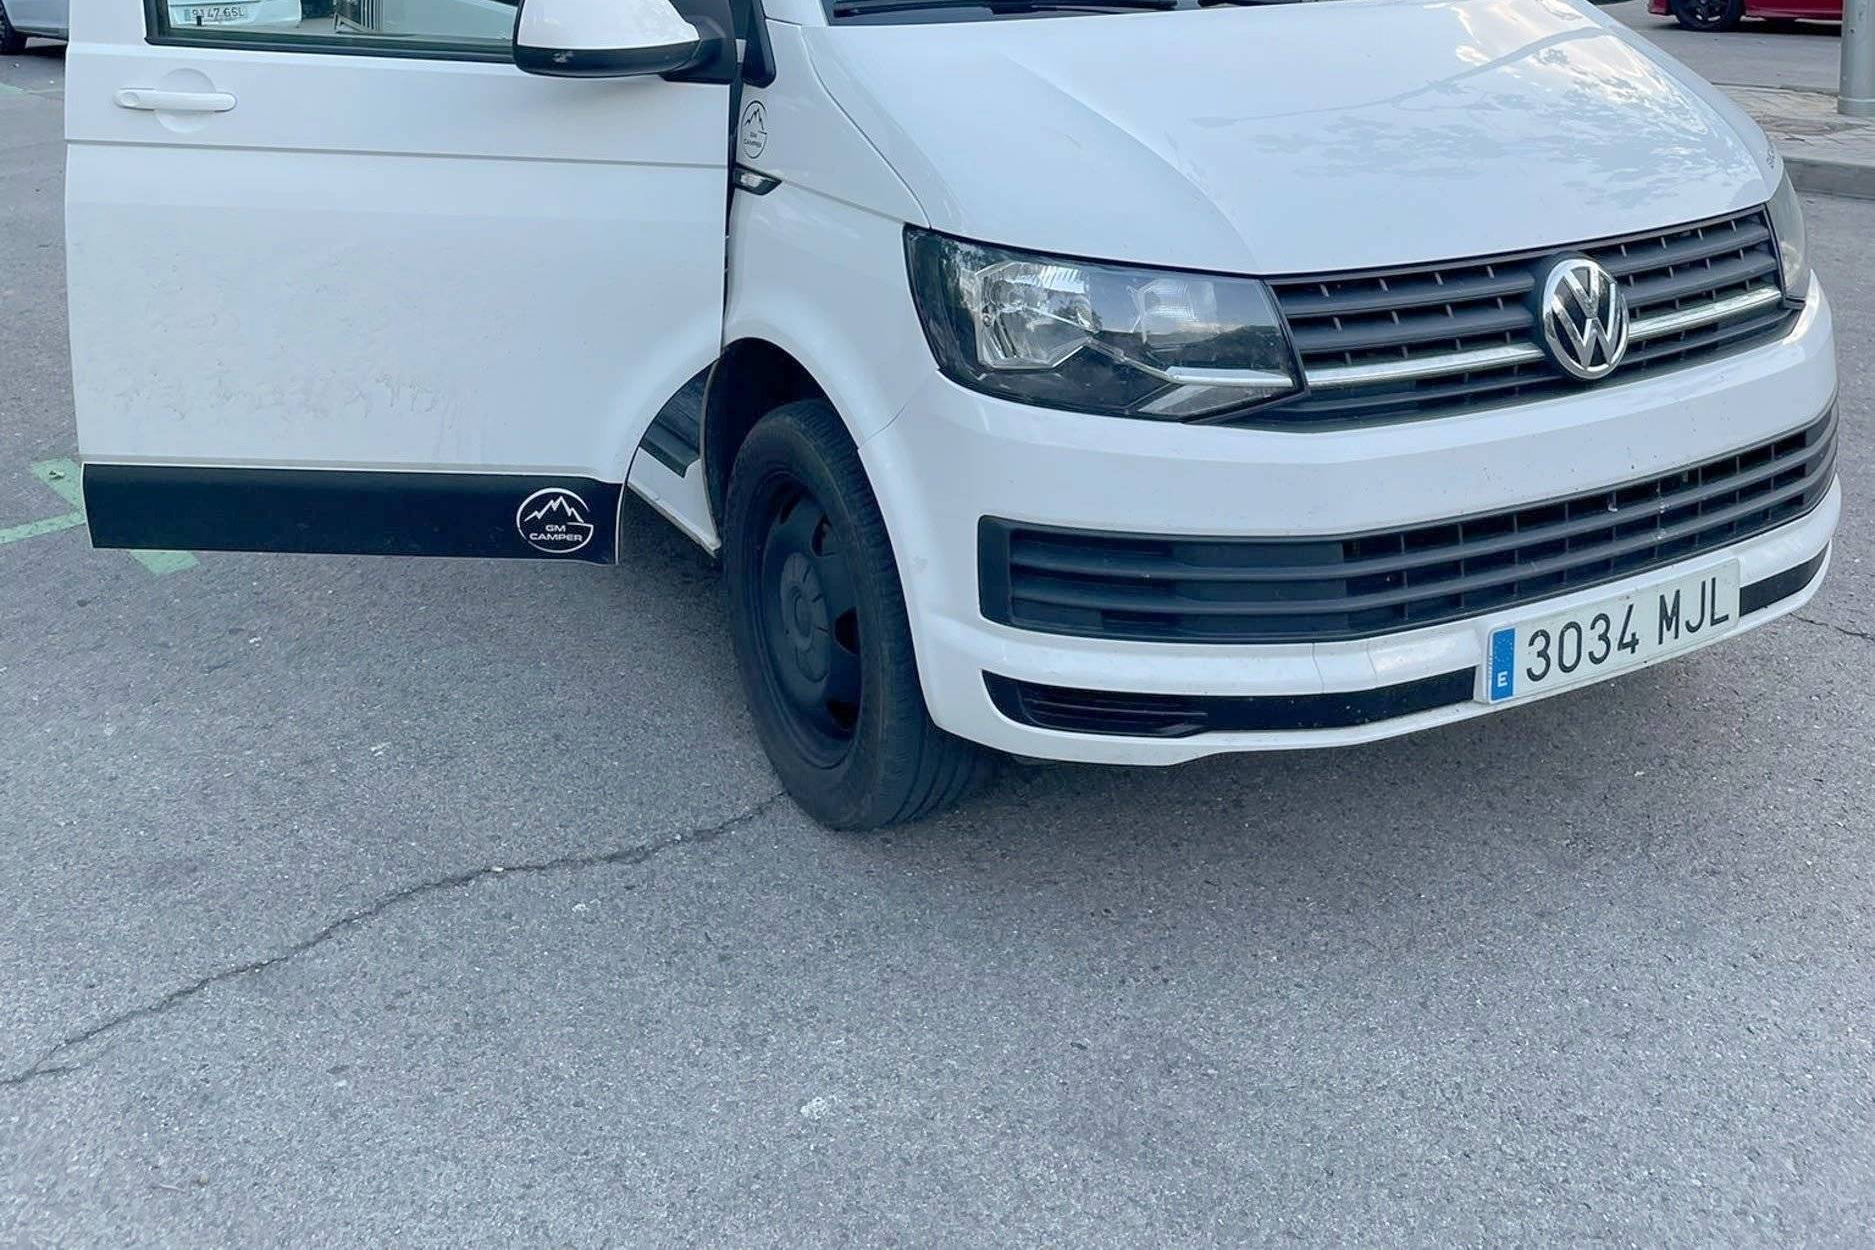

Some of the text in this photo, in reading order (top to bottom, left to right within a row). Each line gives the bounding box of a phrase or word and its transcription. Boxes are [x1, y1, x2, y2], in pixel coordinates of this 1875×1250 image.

[545, 524, 566, 532] GM
[529, 533, 583, 542] CAMPER
[1526, 577, 1730, 682] 3034 MJL
[1497, 670, 1509, 688] E
